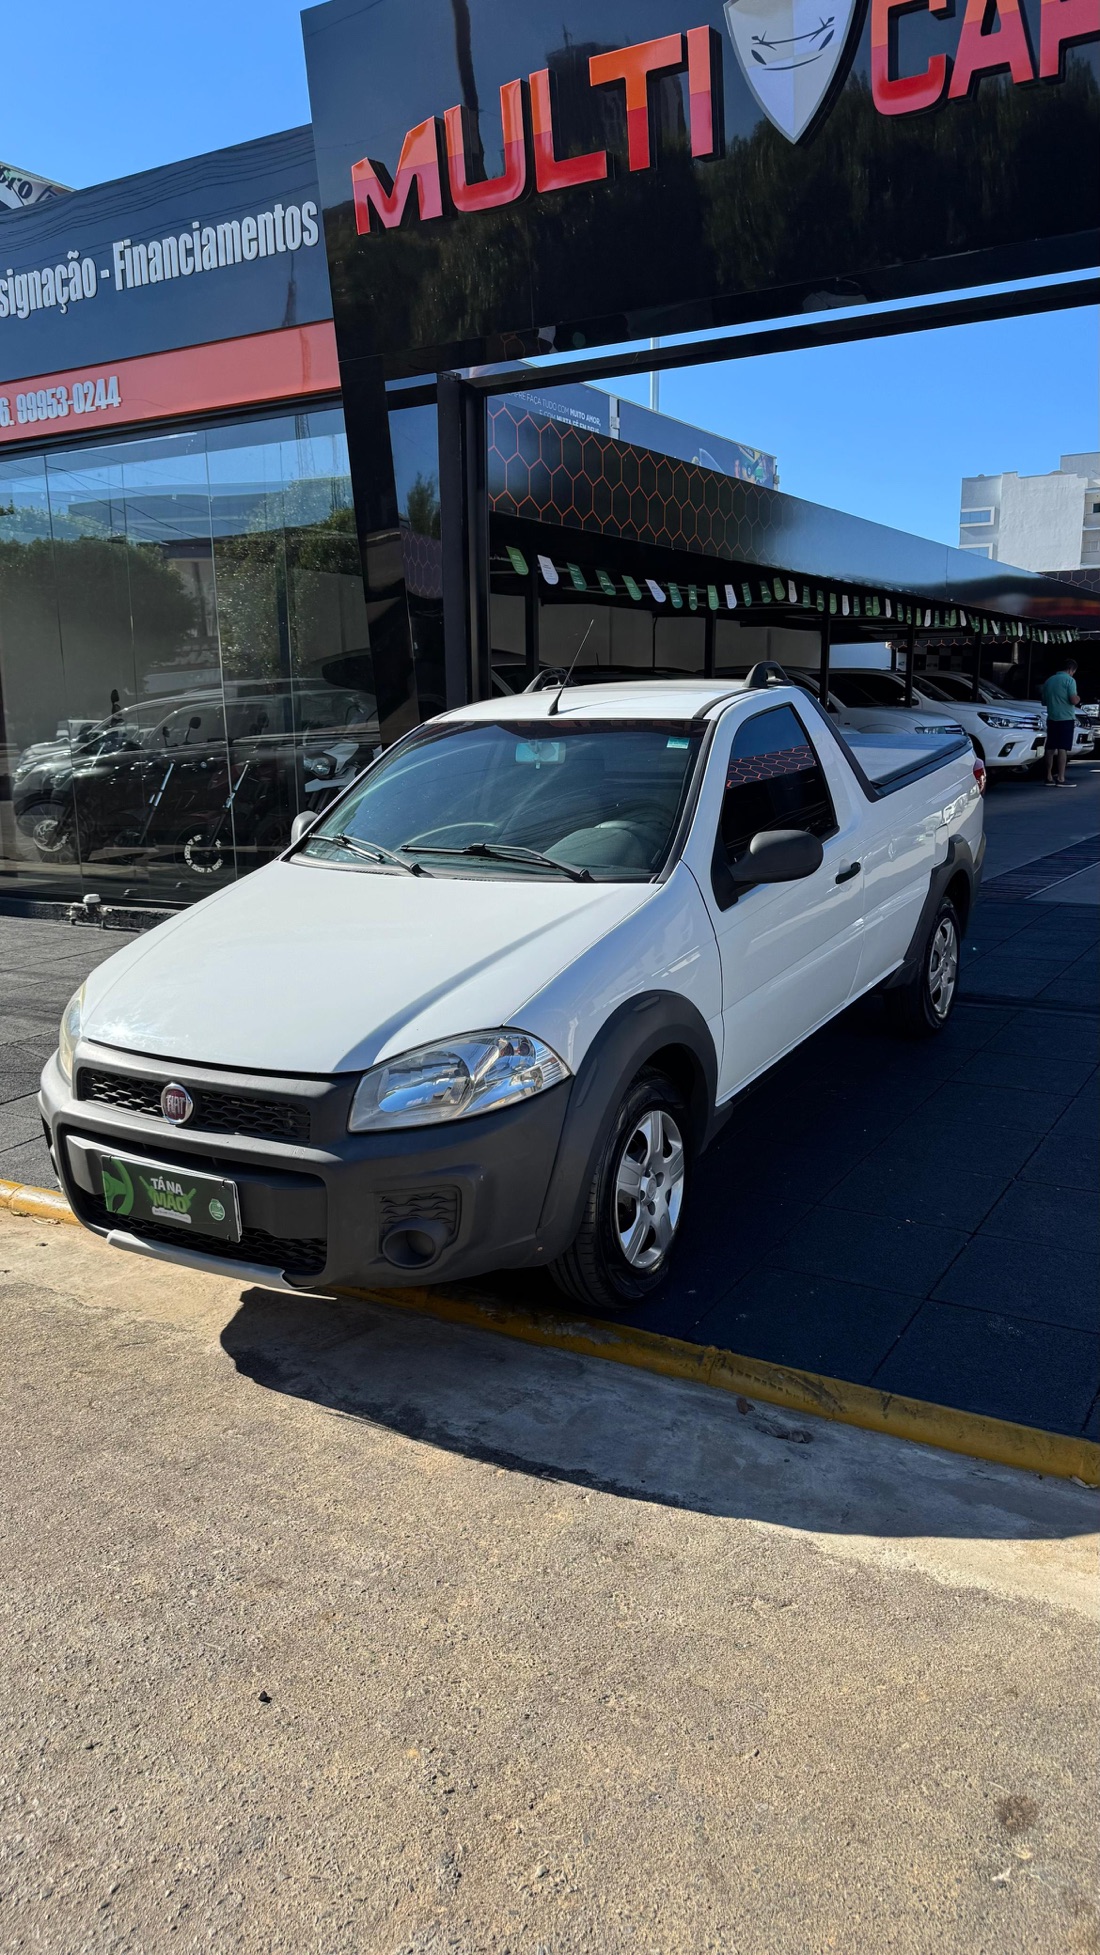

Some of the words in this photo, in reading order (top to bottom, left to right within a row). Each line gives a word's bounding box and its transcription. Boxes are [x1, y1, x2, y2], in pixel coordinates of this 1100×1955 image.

[351, 25, 711, 236] MULTI
[113, 201, 319, 290] Financiamentos
[17, 376, 121, 423] 99953-0244
[543, 399, 556, 410] TUDO
[557, 404, 570, 415] COM
[570, 408, 585, 420] MUITO
[586, 414, 601, 427] AMOR,
[166, 1095, 185, 1114] FIAT
[151, 1176, 166, 1190] TÁ
[167, 1181, 184, 1195] NA
[154, 1193, 188, 1213] MÃO
